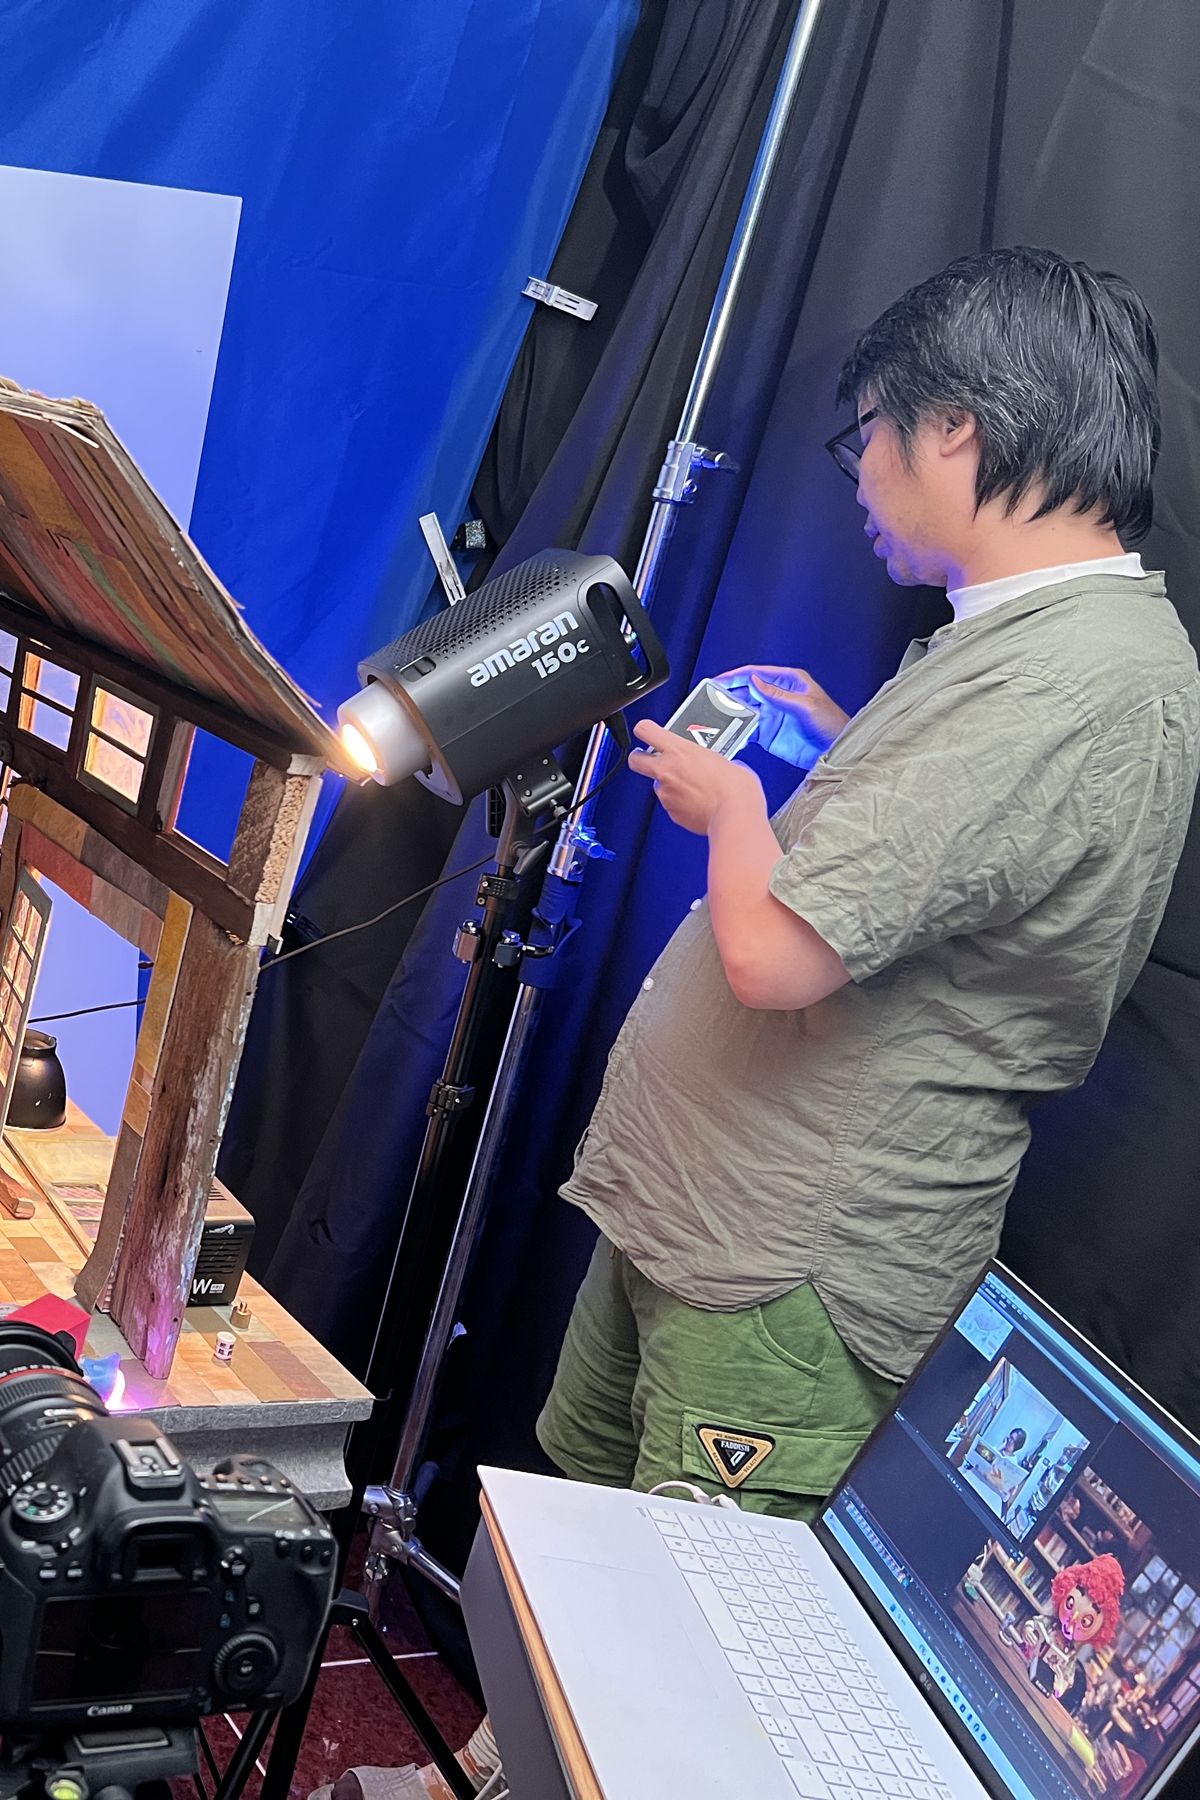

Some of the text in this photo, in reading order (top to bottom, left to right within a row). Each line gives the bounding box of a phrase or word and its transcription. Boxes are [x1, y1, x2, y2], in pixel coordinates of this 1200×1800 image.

[466, 610, 579, 688] amaran
[531, 639, 590, 679] 150c
[87, 1704, 133, 1717] Canon
